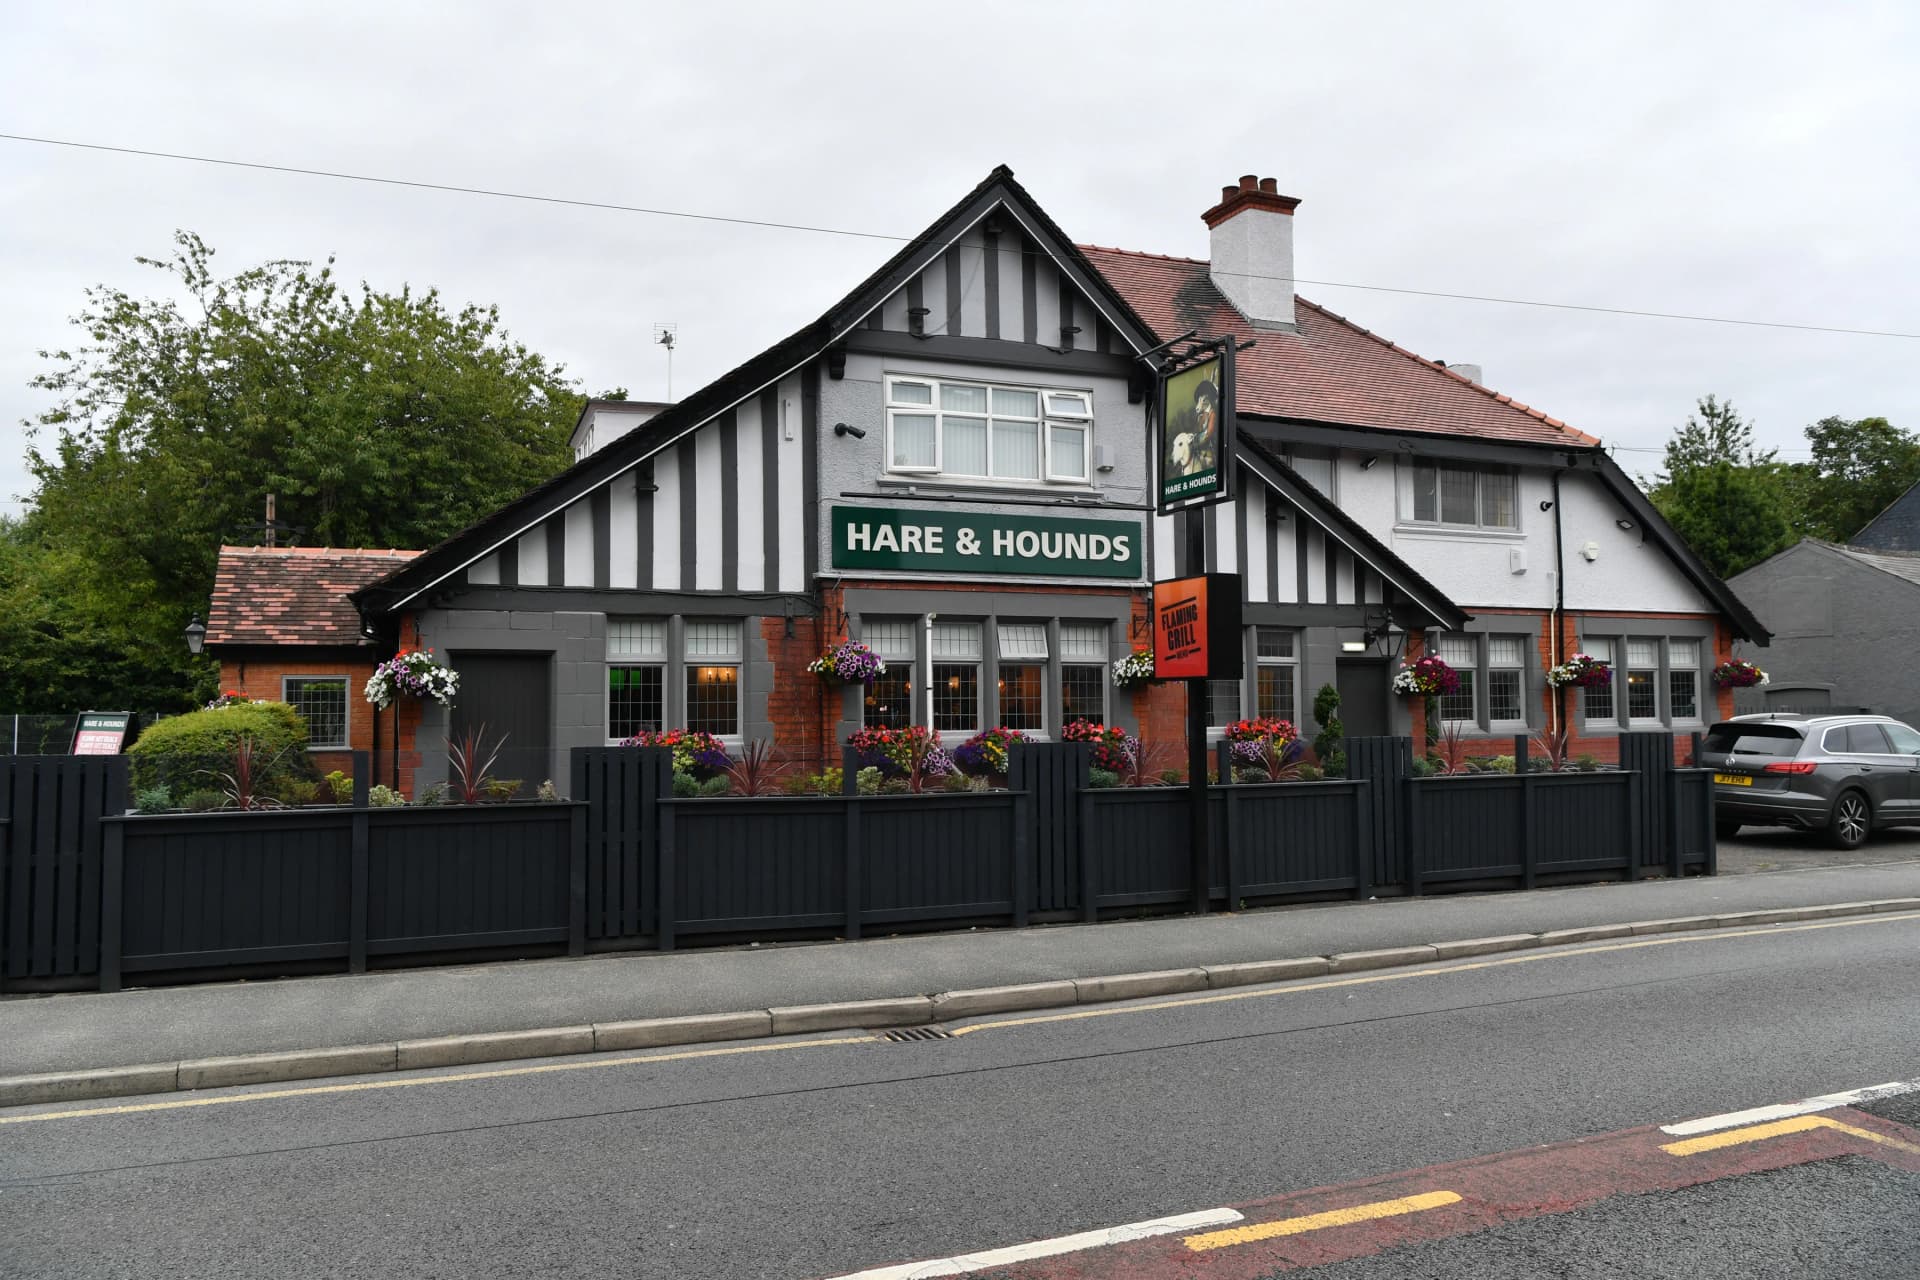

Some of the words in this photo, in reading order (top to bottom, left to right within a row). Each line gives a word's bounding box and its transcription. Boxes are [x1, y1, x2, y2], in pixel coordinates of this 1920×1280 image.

[1165, 483, 1182, 495] HARE
[1183, 482, 1188, 490] &
[1189, 474, 1217, 489] HOUNDS
[847, 522, 944, 554] HARE
[955, 527, 982, 556] &
[993, 530, 1131, 562] HOUNDS
[1161, 604, 1198, 631] FLAMING
[1167, 624, 1196, 650] GRILL
